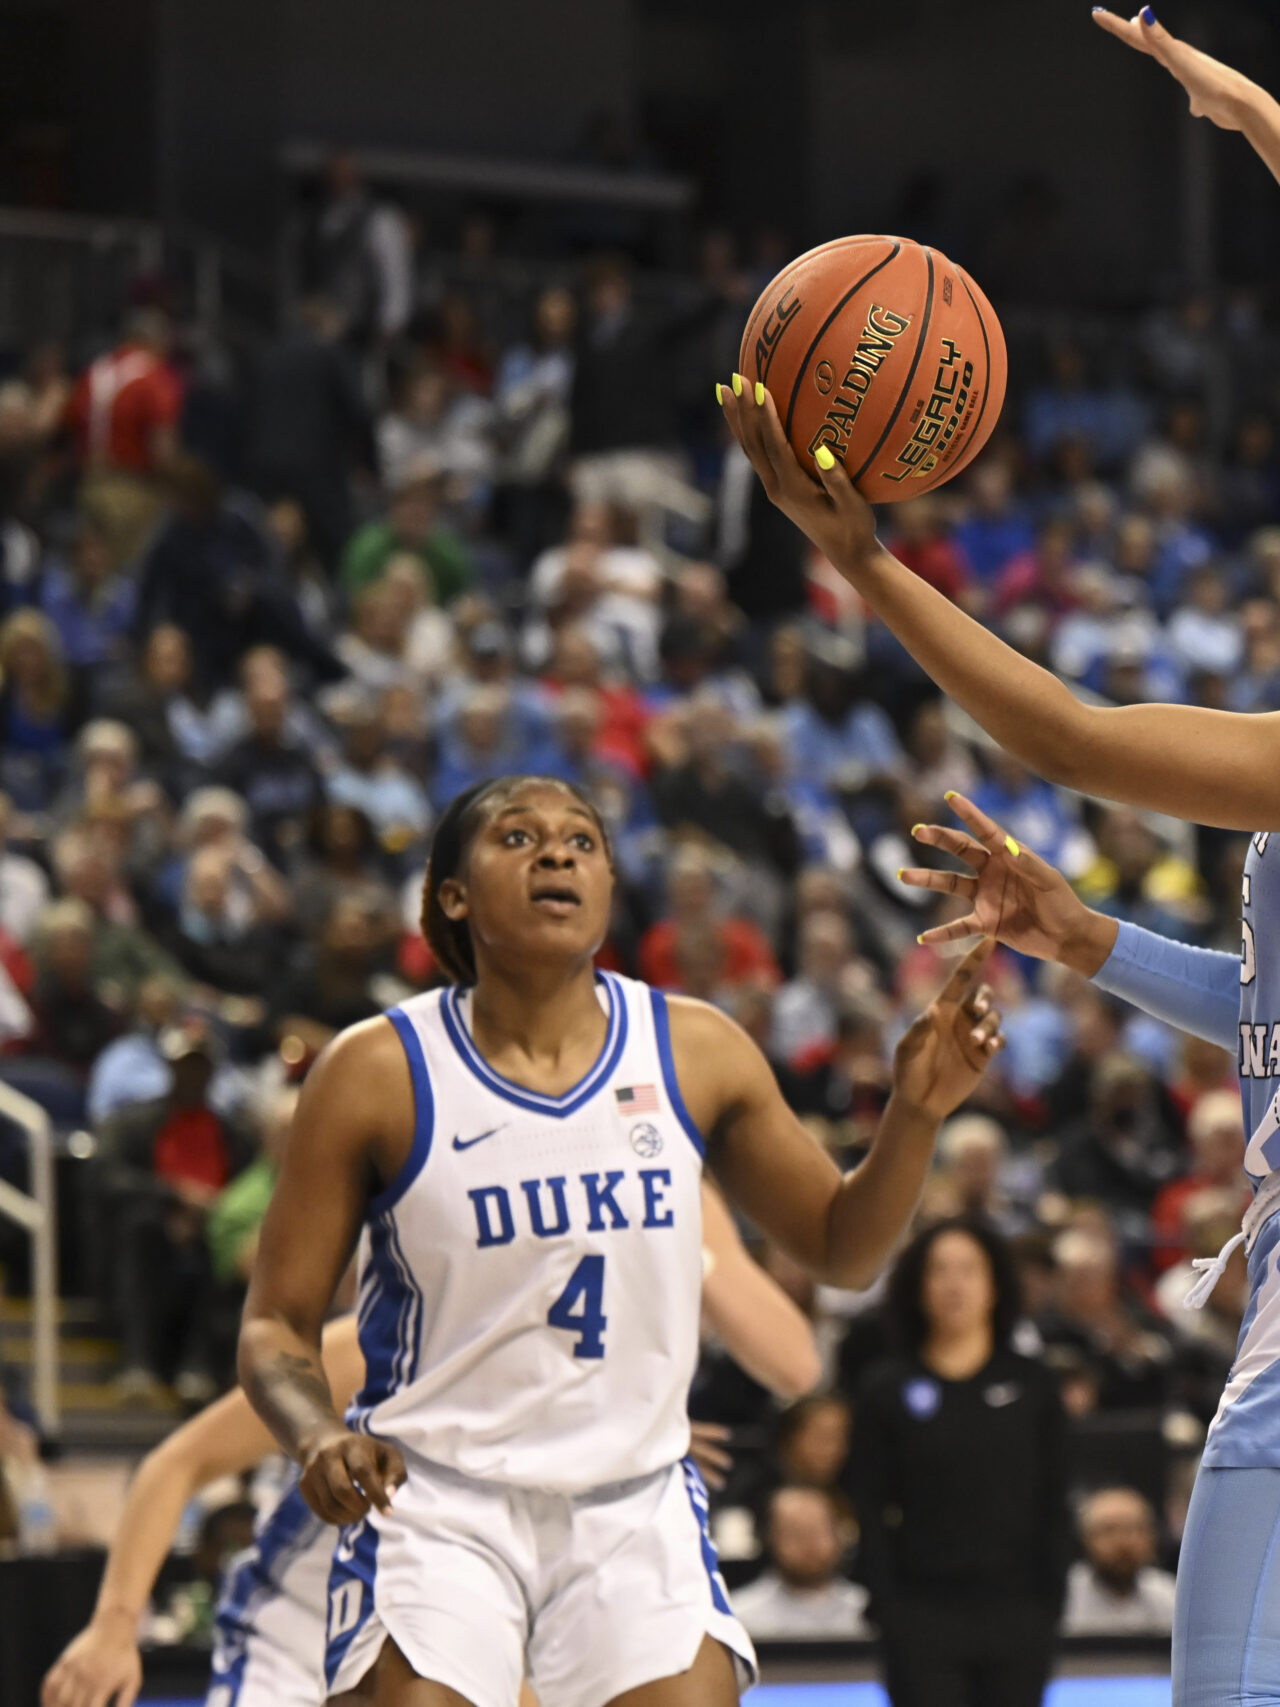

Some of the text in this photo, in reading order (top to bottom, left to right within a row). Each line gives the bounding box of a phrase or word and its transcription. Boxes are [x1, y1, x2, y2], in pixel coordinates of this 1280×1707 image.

[756, 284, 799, 384] ACC
[881, 337, 962, 483] LEGACY
[934, 360, 974, 453] 1000
[467, 1168, 674, 1250] DUKE
[547, 1254, 608, 1360] 4
[327, 1578, 364, 1642] D
